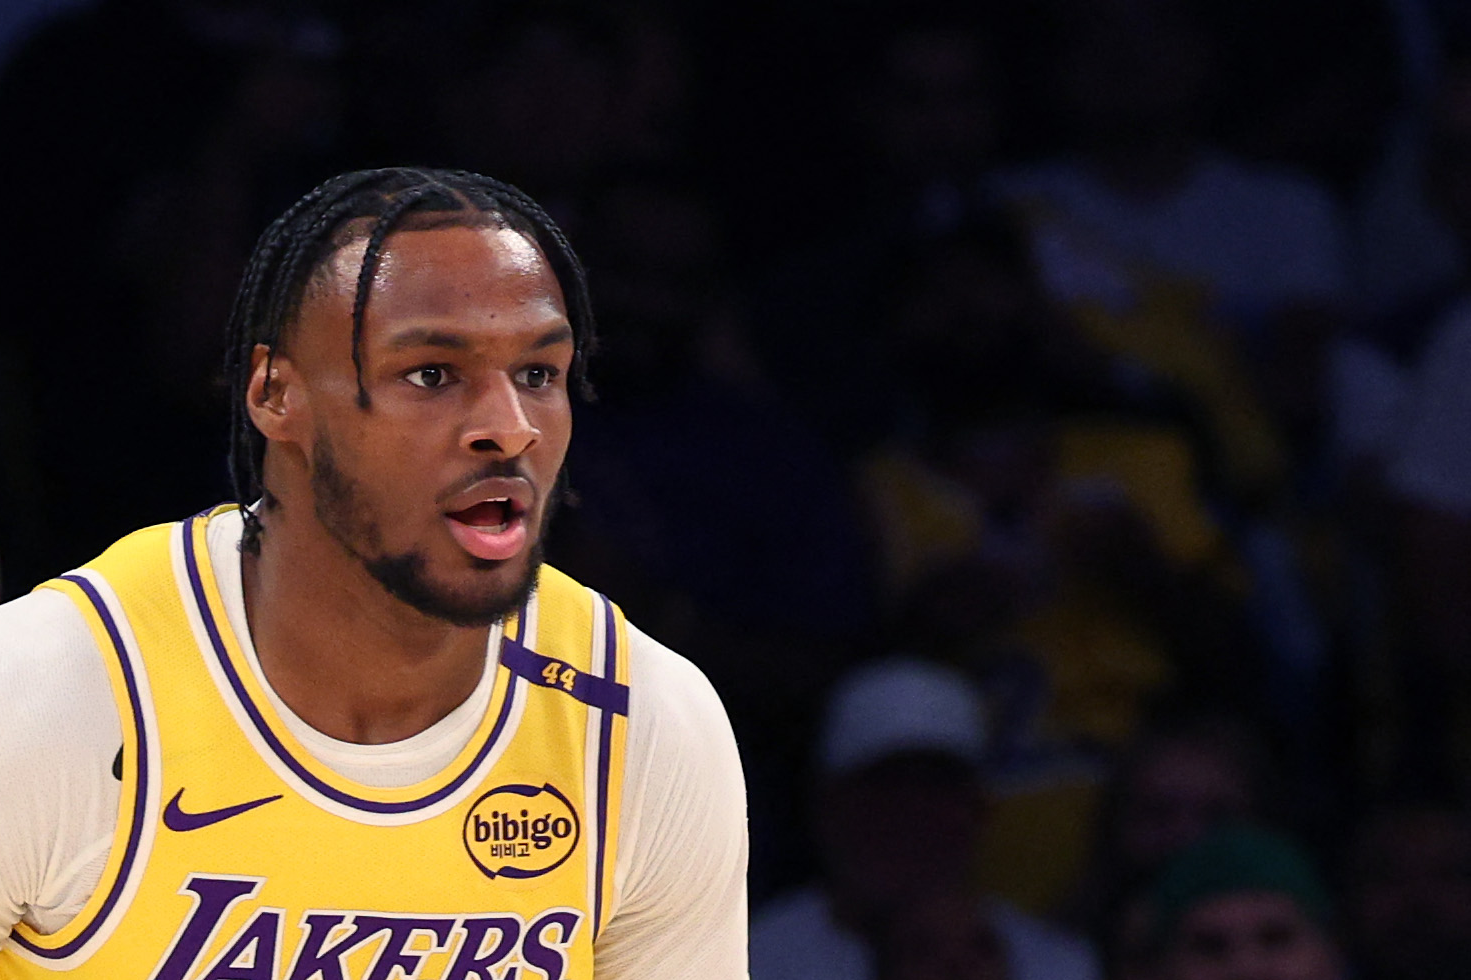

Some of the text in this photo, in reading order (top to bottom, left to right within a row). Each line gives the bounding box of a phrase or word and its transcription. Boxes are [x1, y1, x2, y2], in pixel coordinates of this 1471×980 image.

[542, 662, 576, 691] 44
[473, 810, 572, 850] bibigo
[490, 842, 531, 859] 비비고
